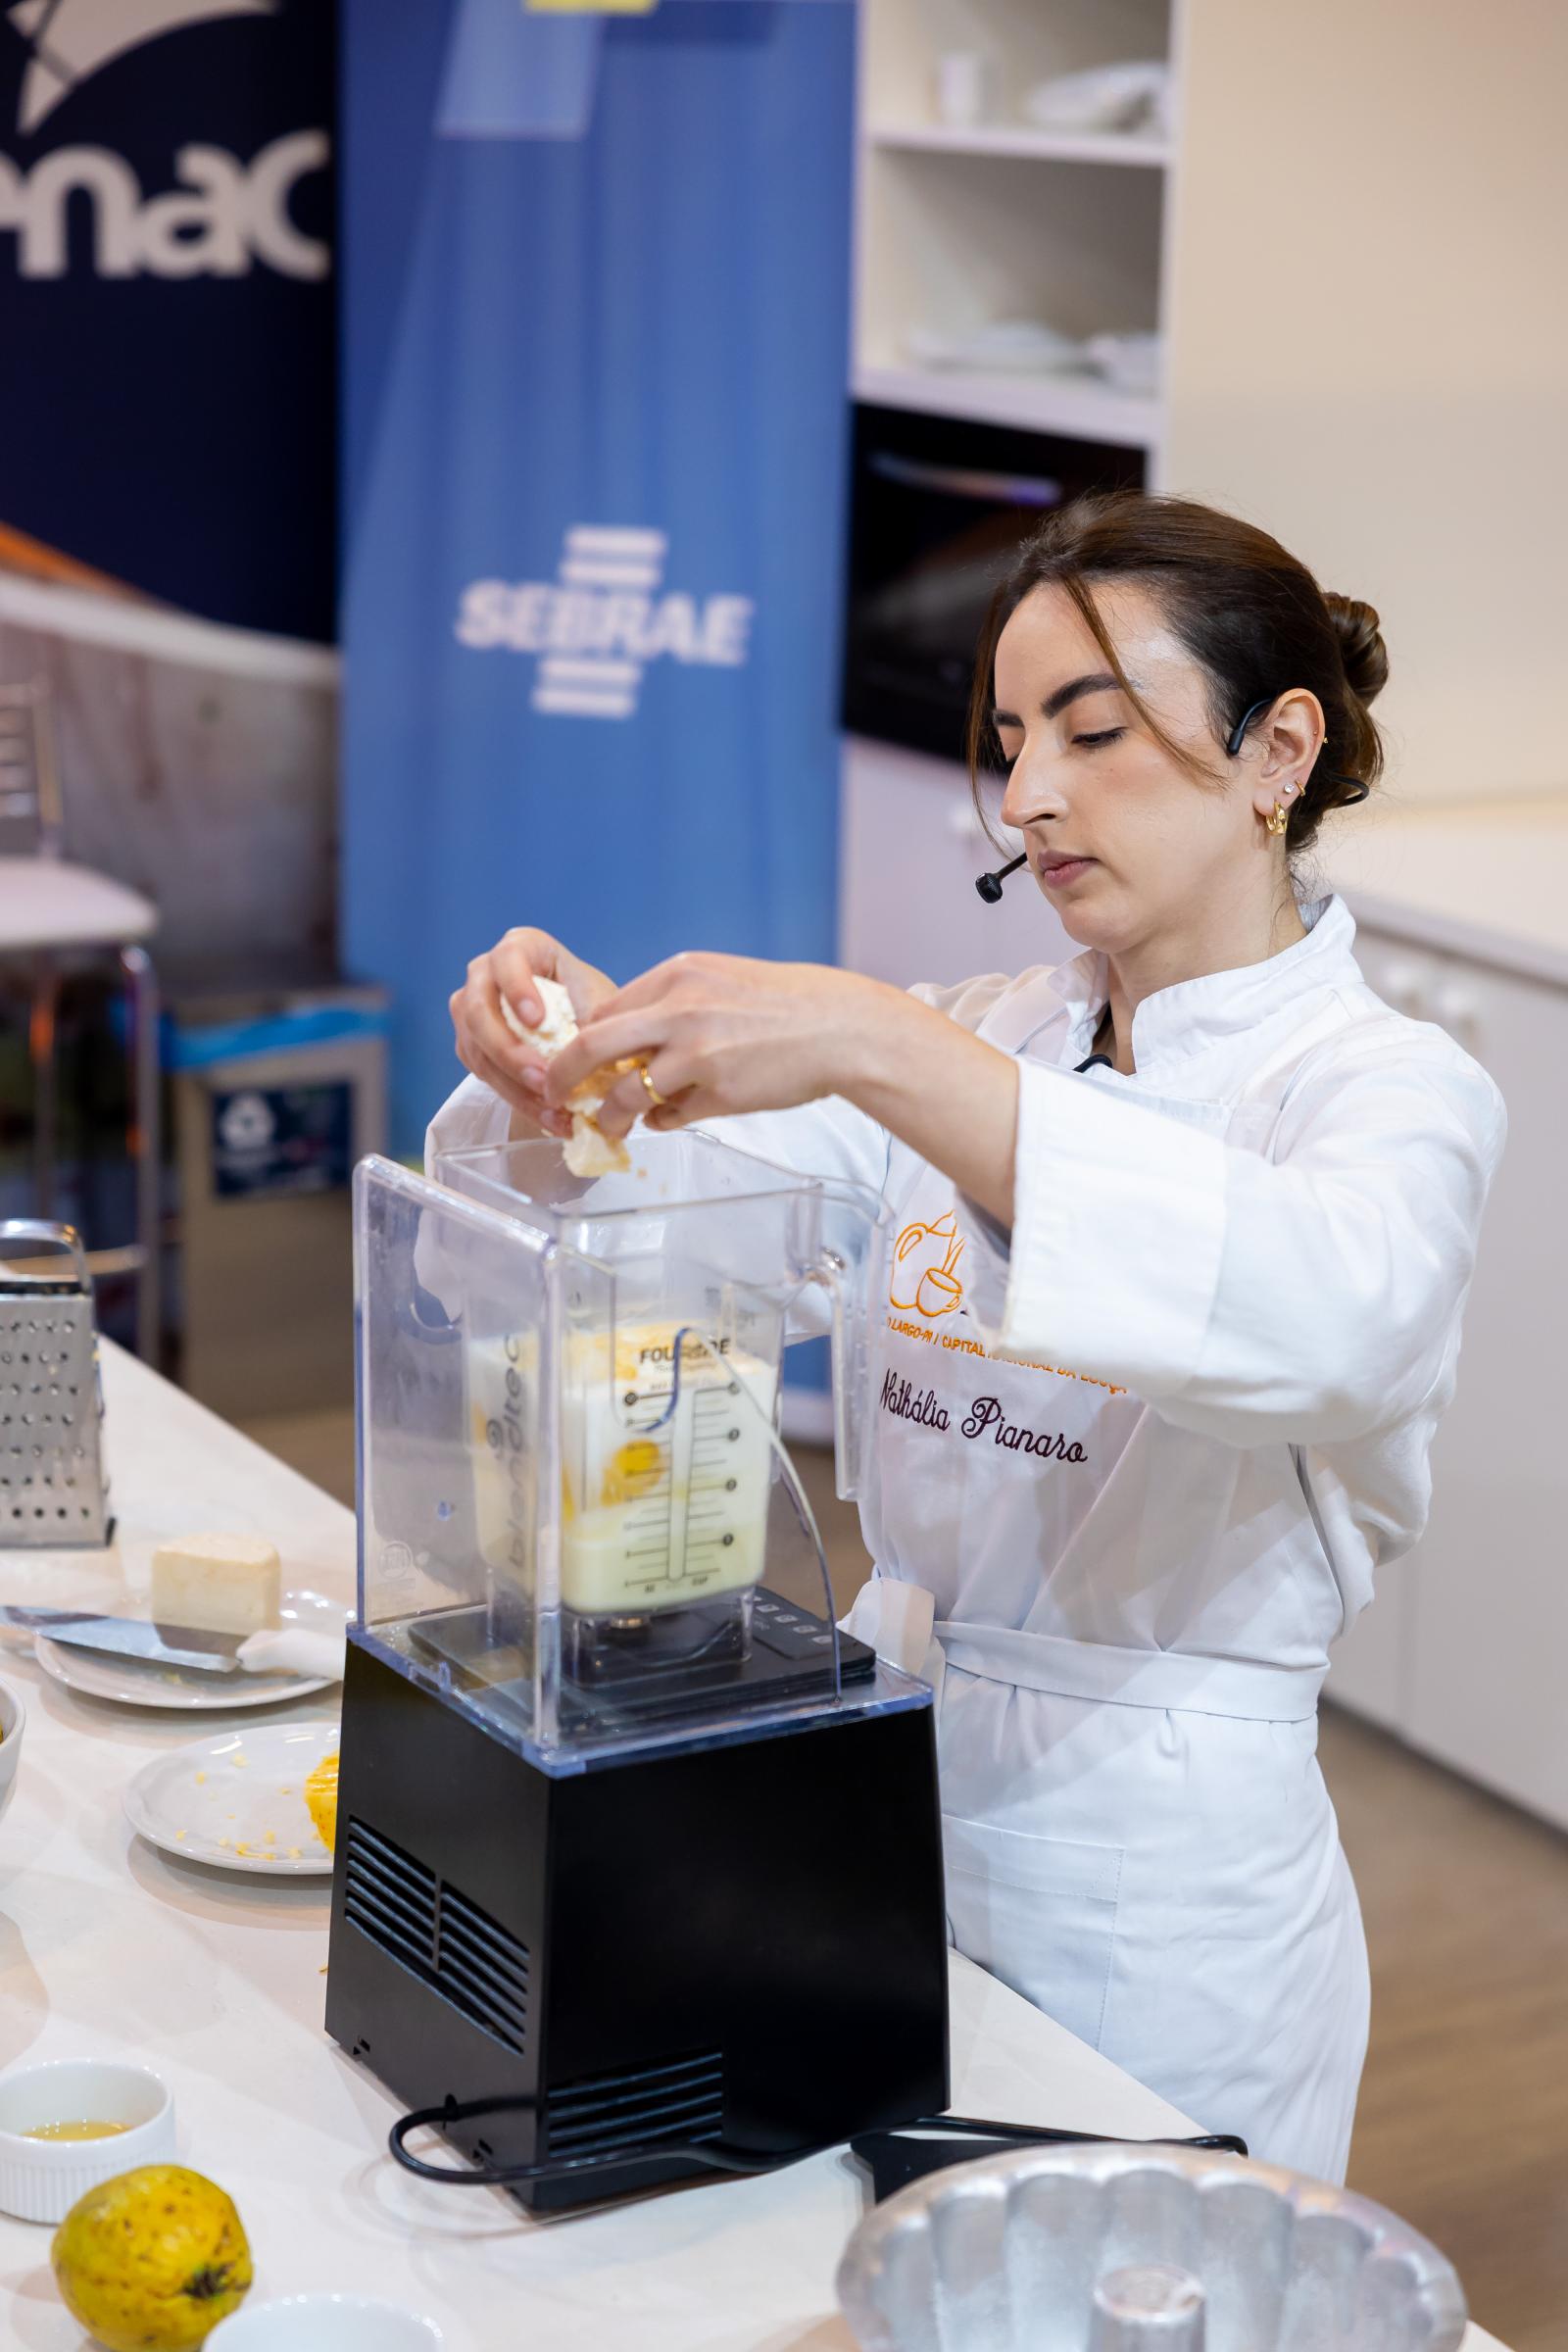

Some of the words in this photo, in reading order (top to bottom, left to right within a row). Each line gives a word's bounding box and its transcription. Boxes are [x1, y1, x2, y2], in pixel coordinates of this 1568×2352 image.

[0, 130, 329, 278] nac
[456, 579, 752, 665] SEBRAE
[942, 1335, 986, 1358] CAPITAL
[503, 1333, 527, 1570] blendtec
[880, 1368, 952, 1432] Nathália
[961, 1396, 1089, 1463] Pianaro
